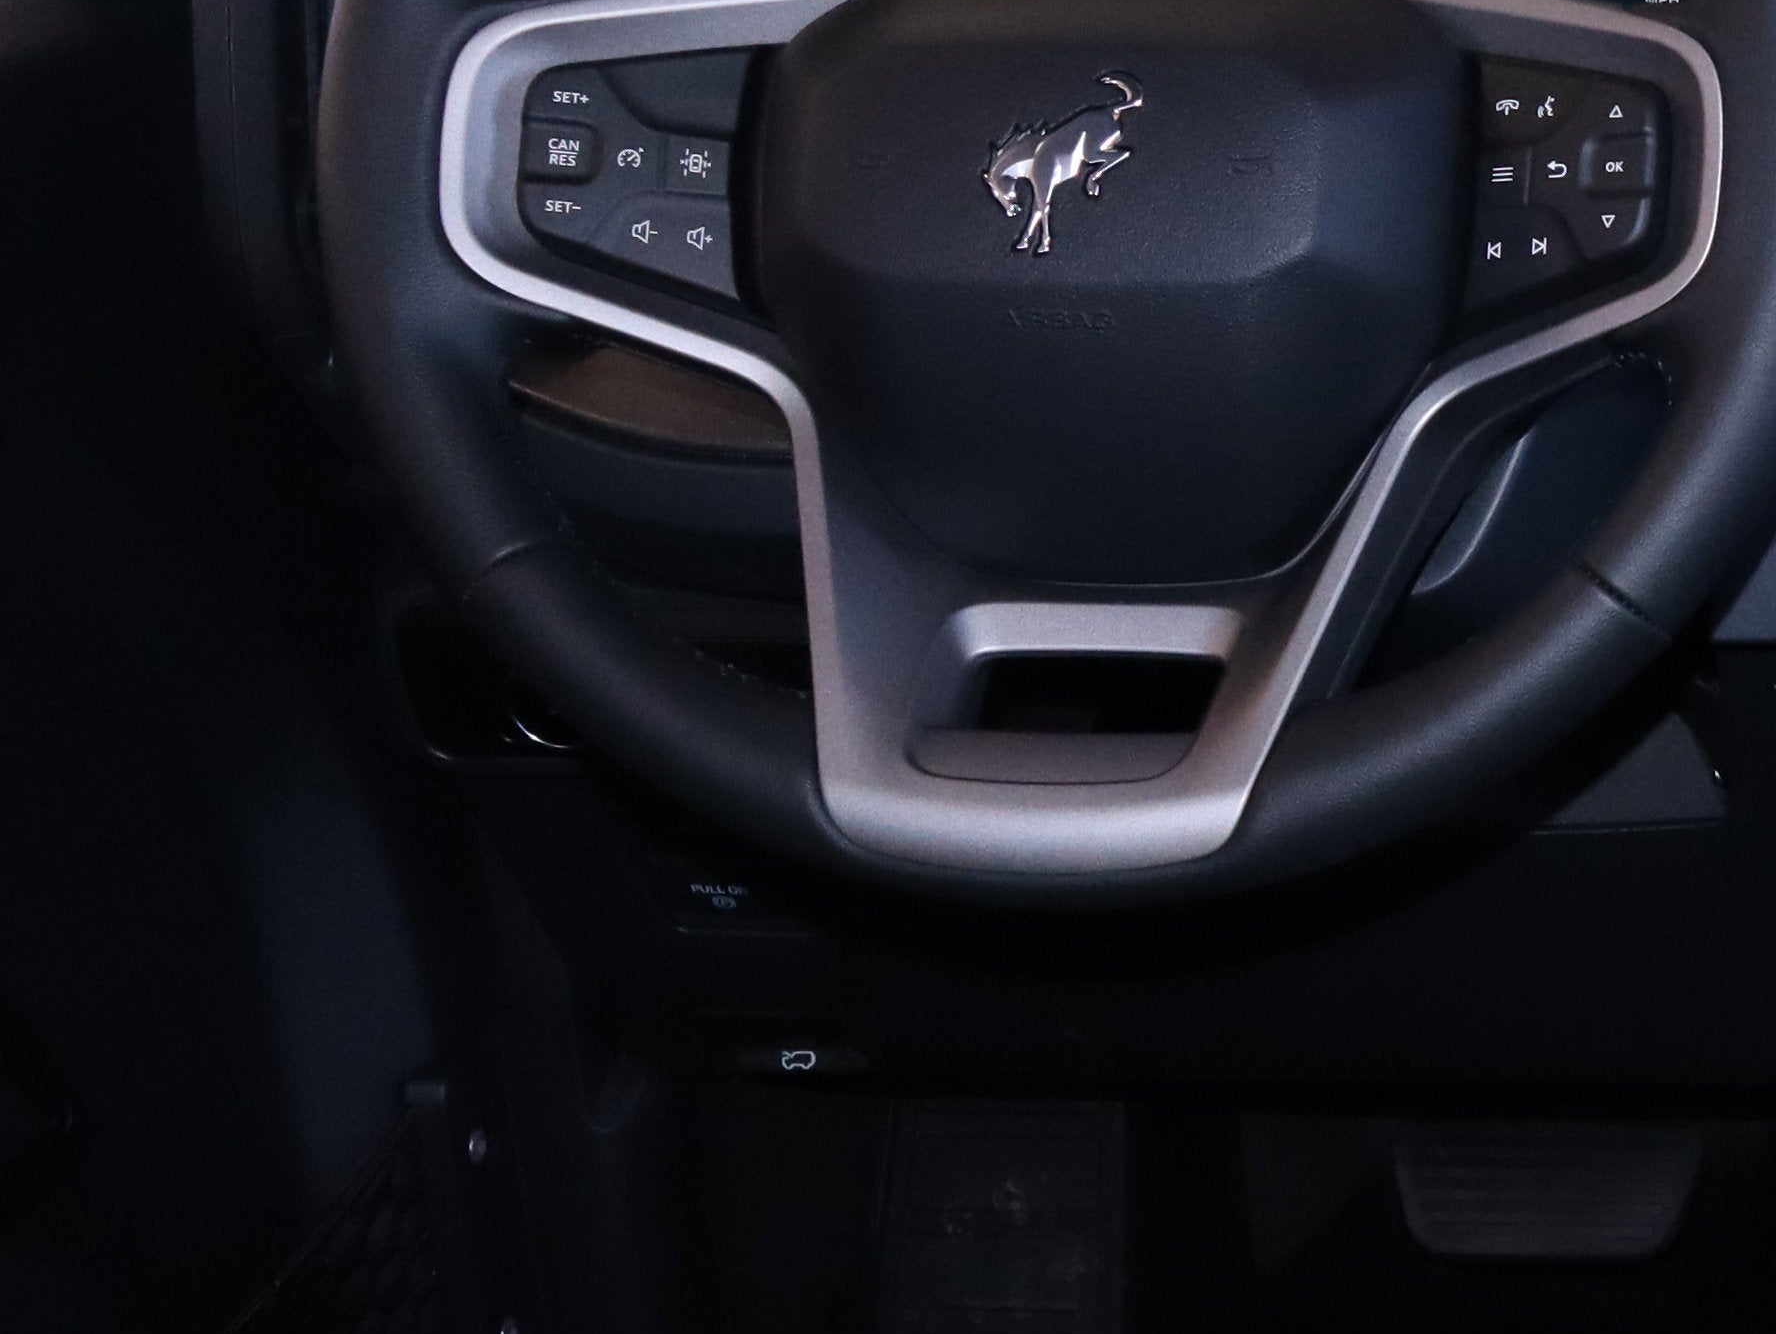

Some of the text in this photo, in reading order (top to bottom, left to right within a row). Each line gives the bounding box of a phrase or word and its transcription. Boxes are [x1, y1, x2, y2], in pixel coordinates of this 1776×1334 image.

[552, 90, 590, 105] SET+
[548, 138, 580, 152] CAN
[548, 154, 577, 167] RES
[1605, 161, 1624, 173] OK
[544, 199, 582, 214] SET-
[690, 883, 726, 894] PULL
